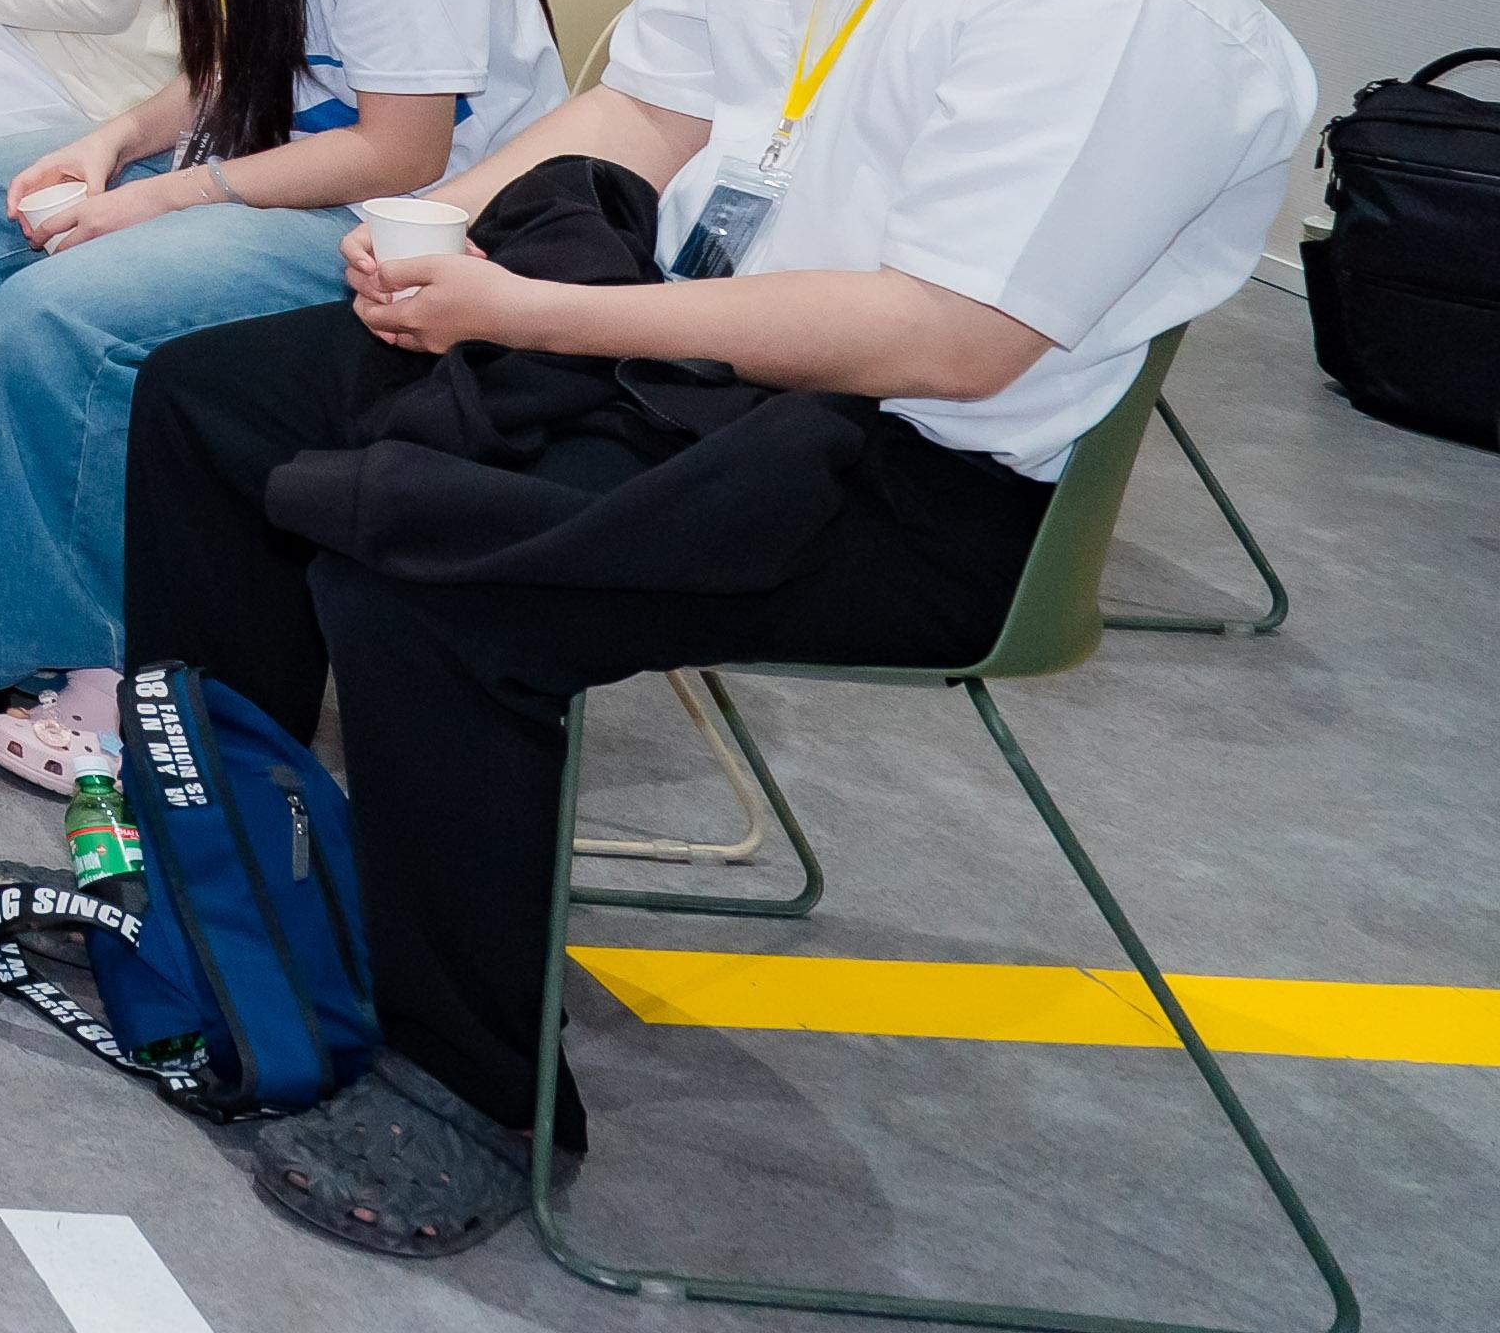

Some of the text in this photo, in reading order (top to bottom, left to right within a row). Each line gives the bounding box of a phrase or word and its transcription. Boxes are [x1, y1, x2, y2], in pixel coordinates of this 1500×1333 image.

[136, 703, 163, 731] ON
[158, 704, 199, 778] FASHION
[148, 742, 178, 776] MY
